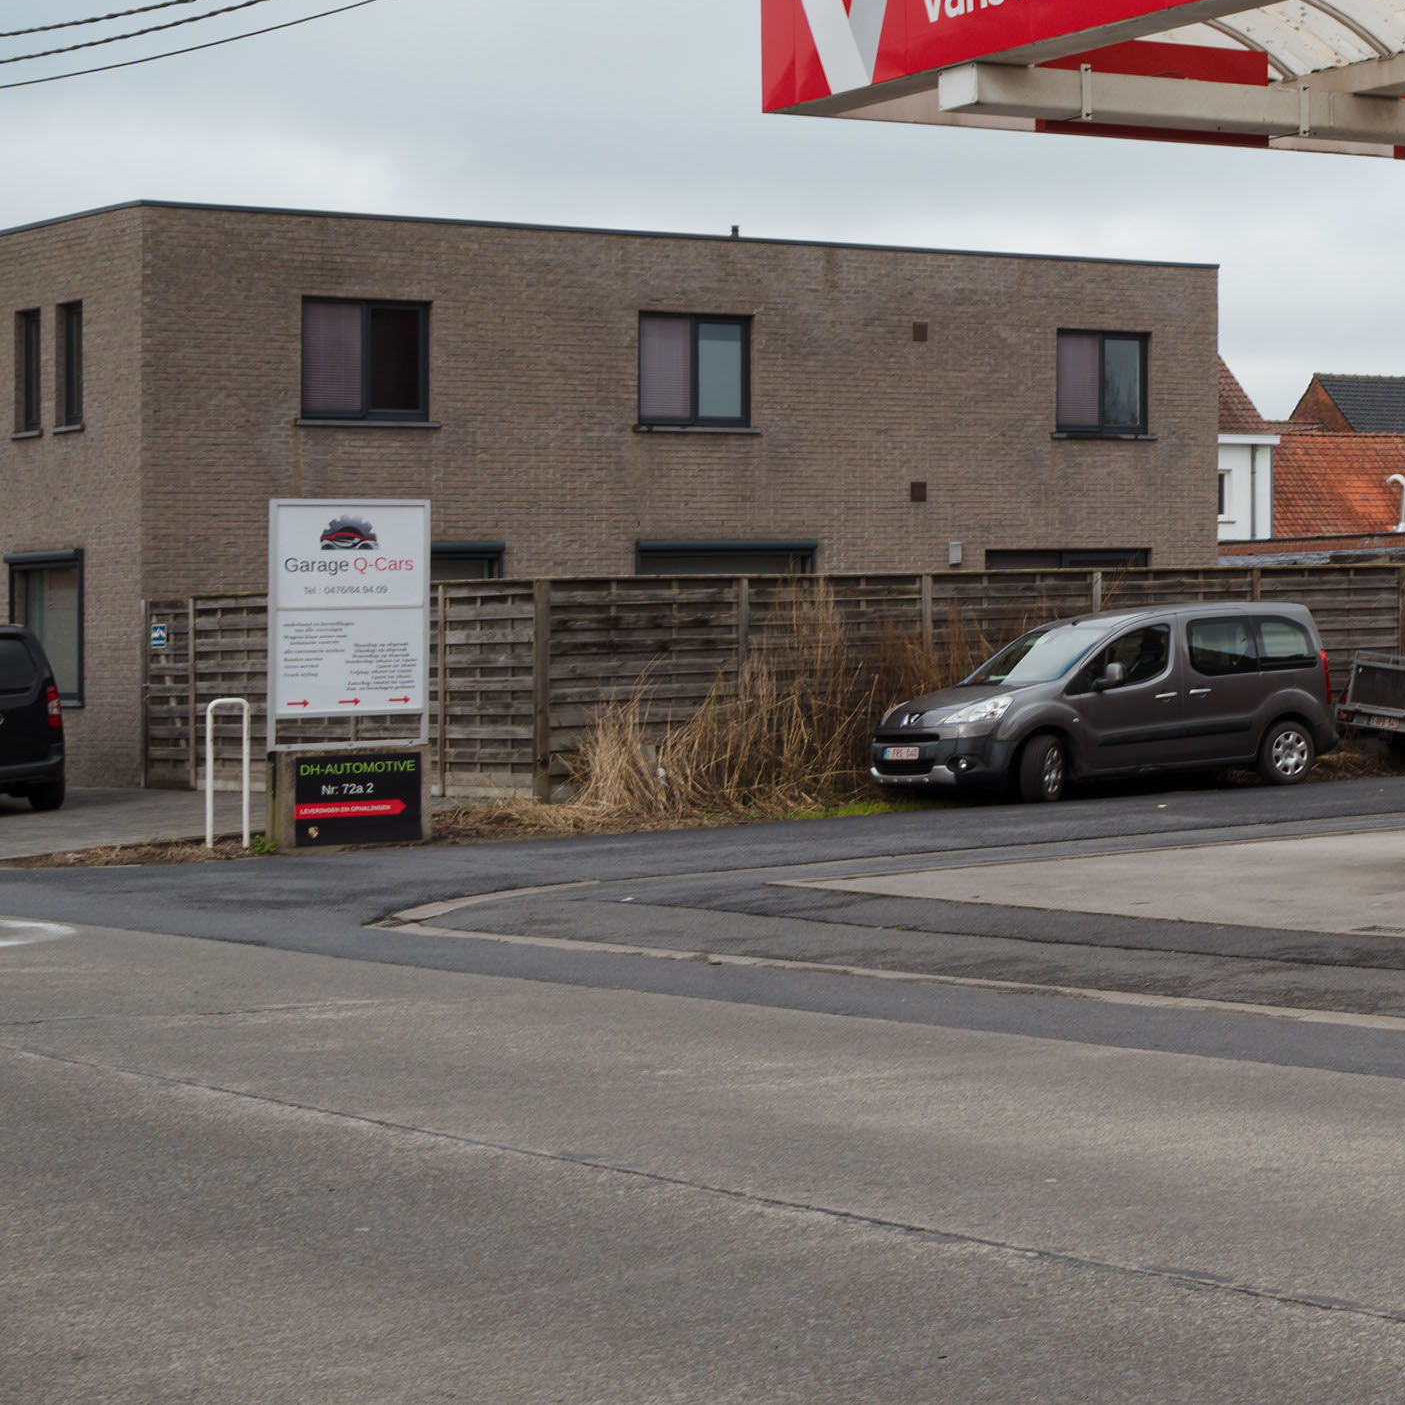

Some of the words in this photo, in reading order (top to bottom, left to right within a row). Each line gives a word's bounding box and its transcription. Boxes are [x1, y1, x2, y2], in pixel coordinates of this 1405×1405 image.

[284, 557, 349, 576] Garage
[353, 556, 414, 575] Q-Cars
[303, 586, 316, 595] Tel
[300, 760, 416, 776] DH-AUTOMOTIVE
[342, 783, 364, 795] 72a
[365, 782, 374, 794] 2
